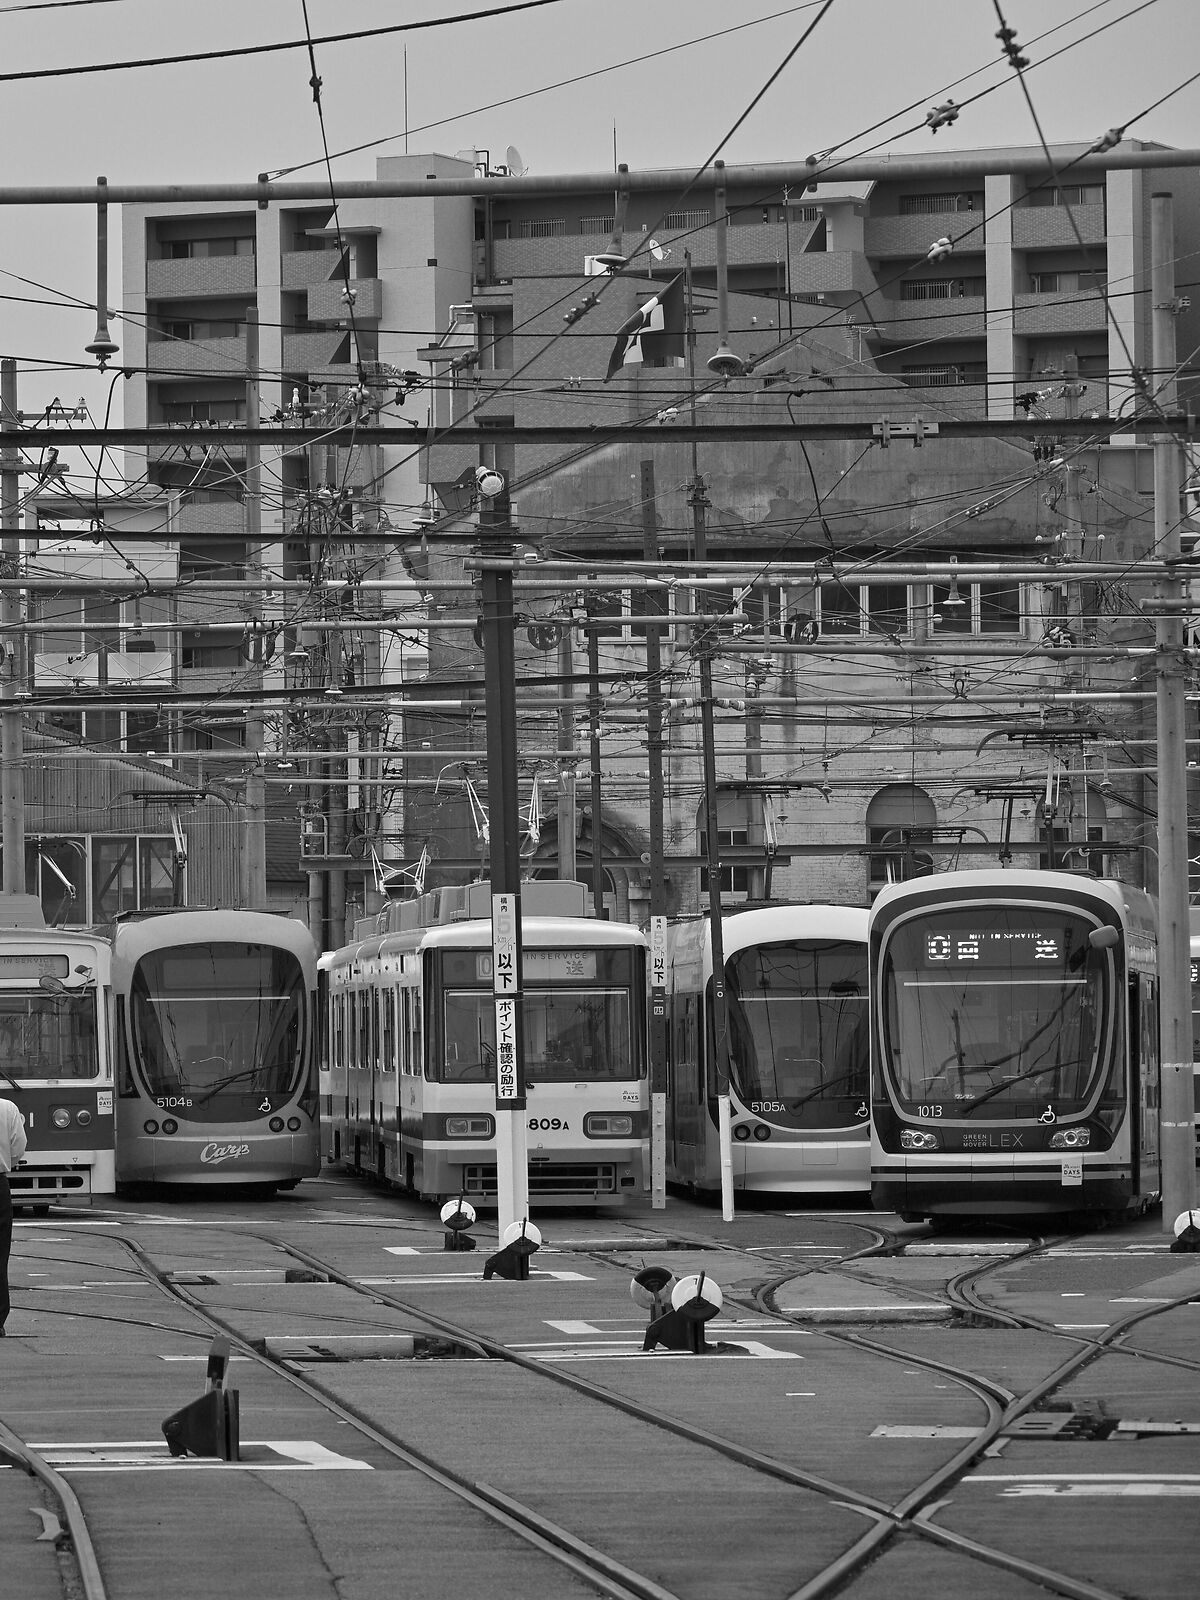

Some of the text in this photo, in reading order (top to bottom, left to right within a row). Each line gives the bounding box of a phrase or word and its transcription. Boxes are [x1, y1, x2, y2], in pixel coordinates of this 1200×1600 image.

[540, 952, 588, 960] SERVICE
[497, 953, 513, 989] 以下
[654, 957, 664, 984] 以下
[499, 1001, 514, 1097] ポイント確認の励行
[156, 1097, 193, 1108] 5104B
[751, 1101, 786, 1112] 5105A
[917, 1105, 943, 1117] 1013
[989, 1133, 1025, 1147] LEX
[200, 1142, 250, 1165] Carp
